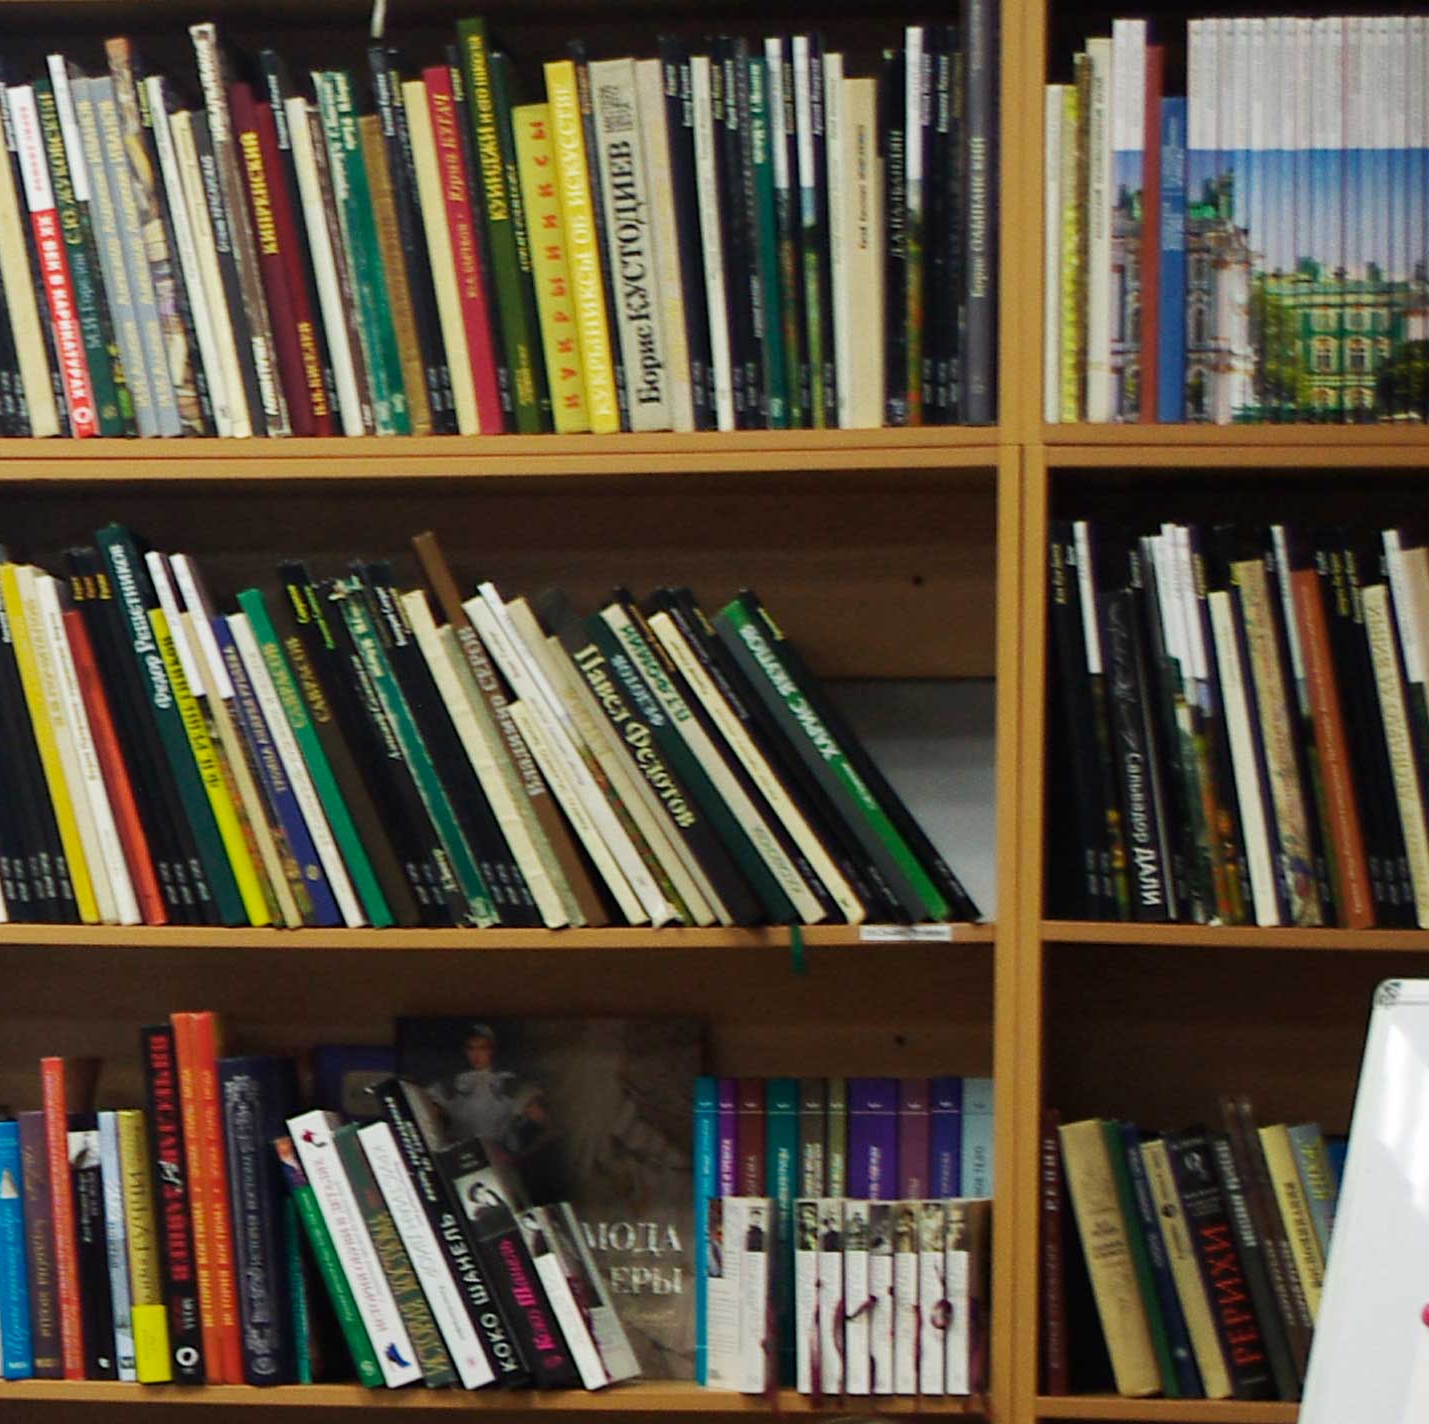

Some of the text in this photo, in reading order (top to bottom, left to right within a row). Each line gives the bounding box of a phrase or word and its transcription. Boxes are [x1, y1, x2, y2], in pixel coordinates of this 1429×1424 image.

[239, 129, 278, 256] КИПРЕНСКИЙ
[570, 214, 591, 245] ОБ
[608, 139, 662, 407] Борис КУСТОДИЕВ
[457, 622, 544, 799] Владимир СЕРОВ
[1136, 846, 1160, 907] ДАЛИ
[367, 1211, 449, 1377] ИСТОРИЯ КОСТЮМА
[437, 1210, 517, 1375] КОКО ШАНЕЛЬ
[581, 1222, 682, 1252] МОДА
[1200, 1223, 1260, 1366] РЕРИХИ
